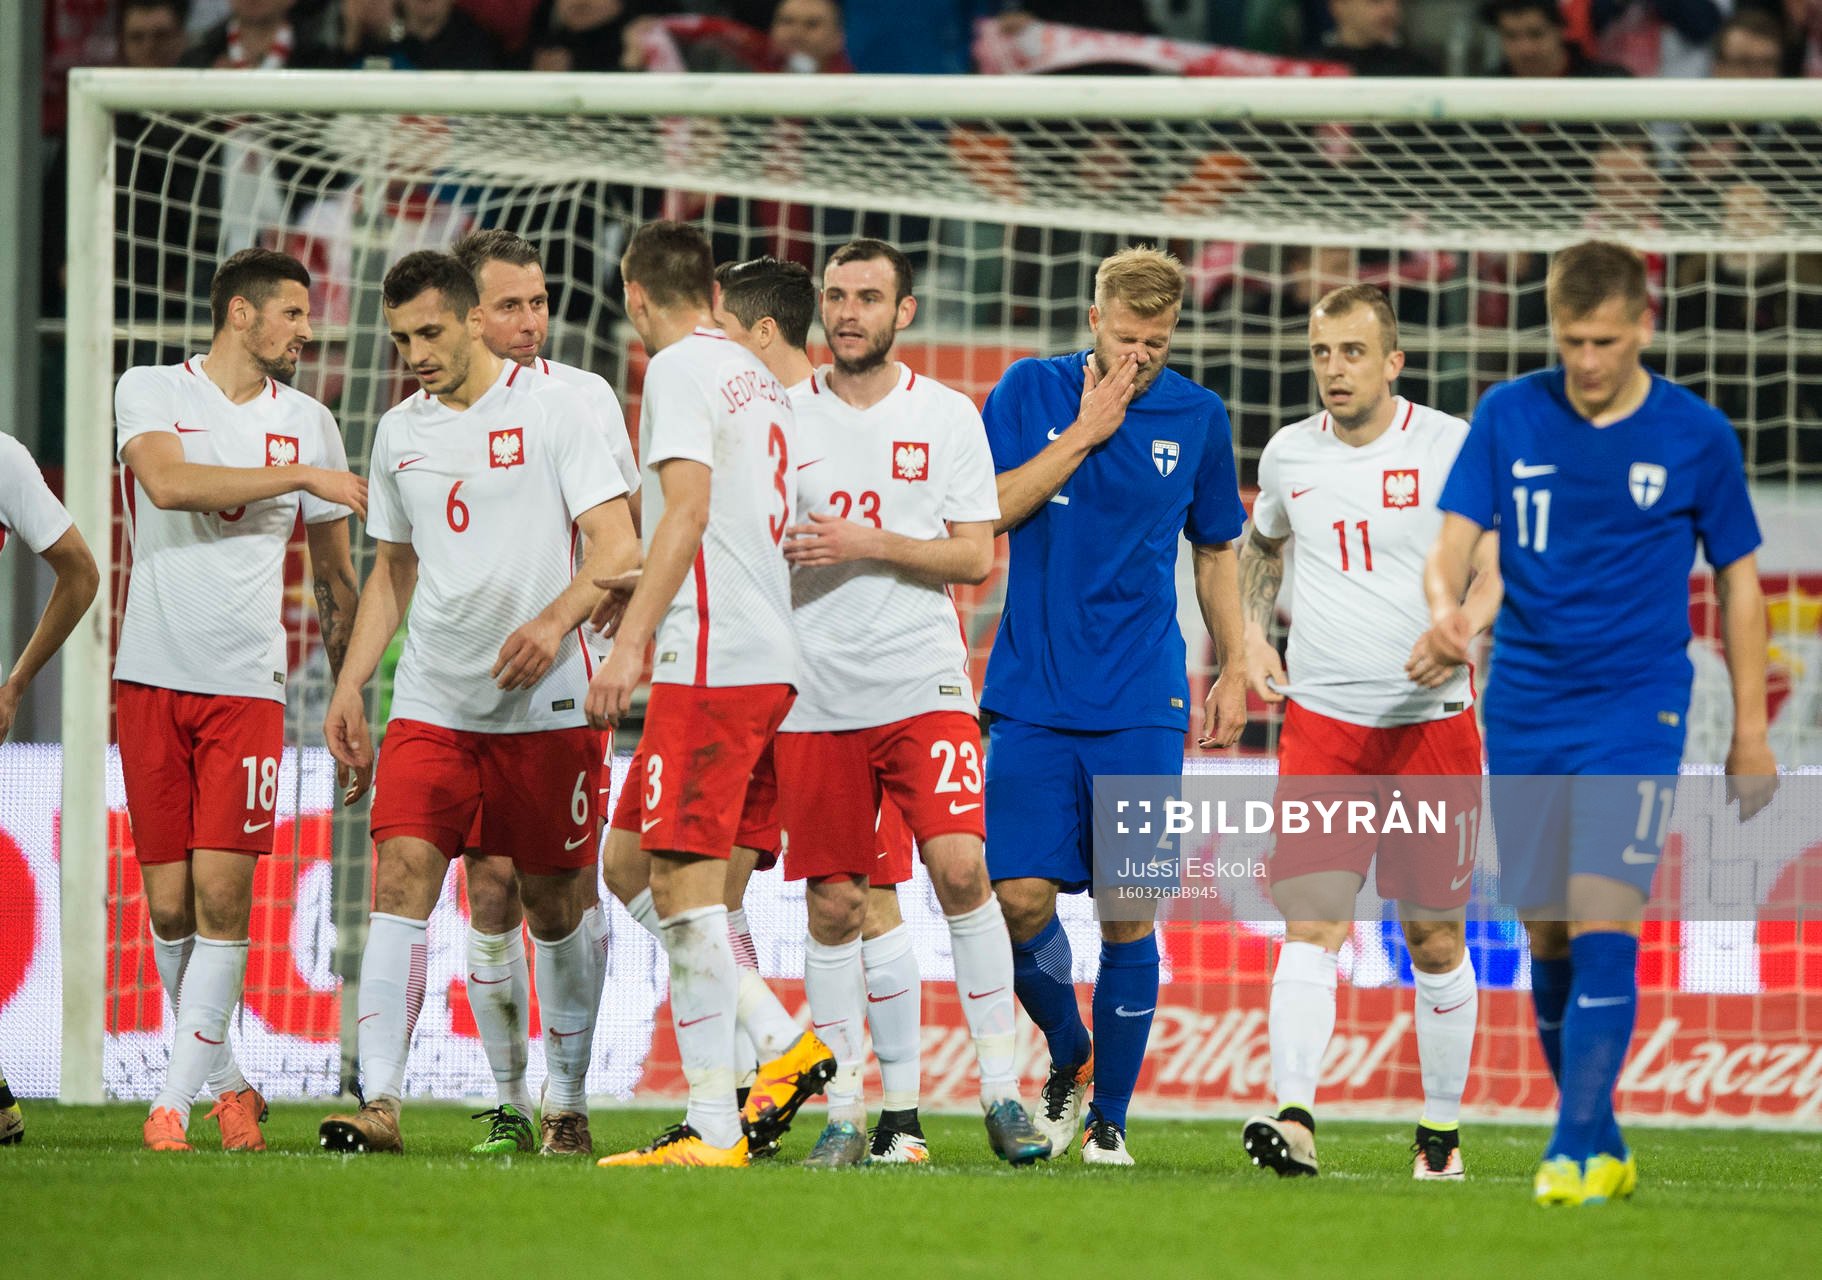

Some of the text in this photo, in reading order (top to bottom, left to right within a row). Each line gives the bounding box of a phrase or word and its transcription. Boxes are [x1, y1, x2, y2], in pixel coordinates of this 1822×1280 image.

[447, 480, 469, 533] 6
[768, 422, 789, 546] 3
[829, 490, 882, 529] 23
[1333, 520, 1372, 571] 11
[1512, 486, 1552, 552] 11
[242, 755, 278, 811] 18
[645, 753, 664, 811] 3
[931, 739, 983, 795] 23
[571, 770, 589, 826] 6
[1635, 780, 1674, 848] 11
[1455, 806, 1477, 866] 11
